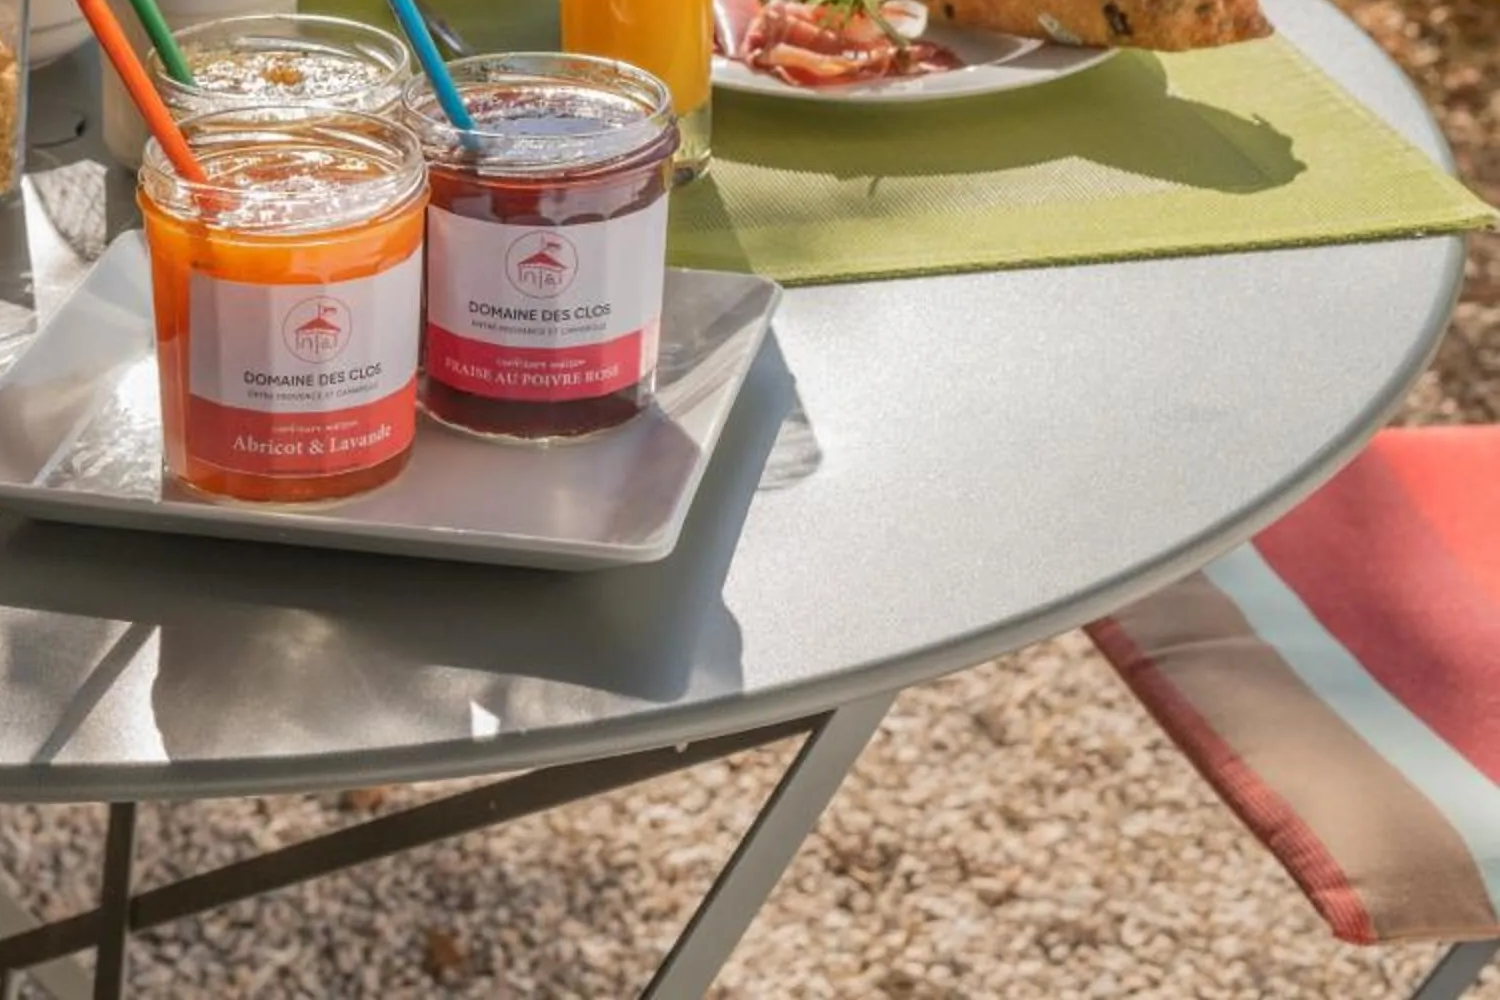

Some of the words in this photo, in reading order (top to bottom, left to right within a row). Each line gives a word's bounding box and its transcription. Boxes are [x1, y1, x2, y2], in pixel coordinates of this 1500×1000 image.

[468, 301, 537, 321] DOMAINE
[542, 309, 570, 322] DES
[574, 303, 611, 320] CLOS
[243, 370, 314, 387] DOMAINE
[319, 372, 346, 386] DES
[349, 362, 382, 381] CLOS
[444, 357, 491, 381] FRAISE
[495, 372, 518, 385] AU
[522, 372, 582, 387] POIVRE
[232, 433, 303, 455] Abricot
[309, 439, 325, 455] &
[329, 423, 392, 453] Lavande
